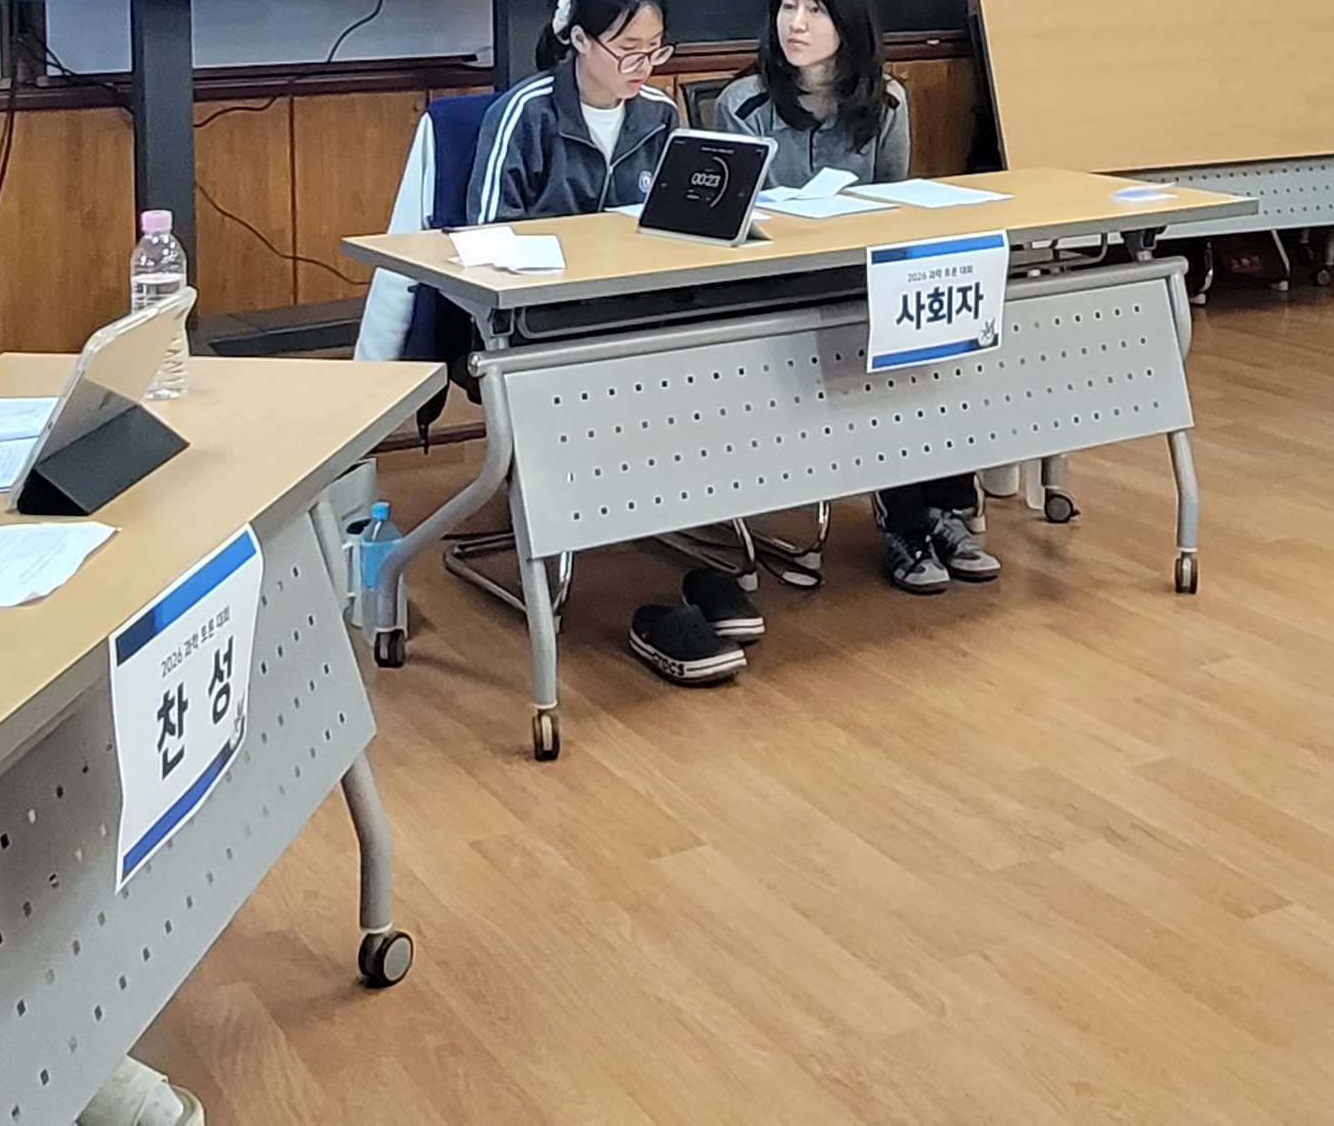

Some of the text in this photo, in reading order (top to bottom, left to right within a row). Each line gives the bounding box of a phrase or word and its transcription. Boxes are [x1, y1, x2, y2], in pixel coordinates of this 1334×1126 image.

[907, 272, 927, 282] 2026
[896, 281, 984, 330] 사회자
[160, 647, 183, 678] 2026
[157, 635, 234, 780] 찬 성
